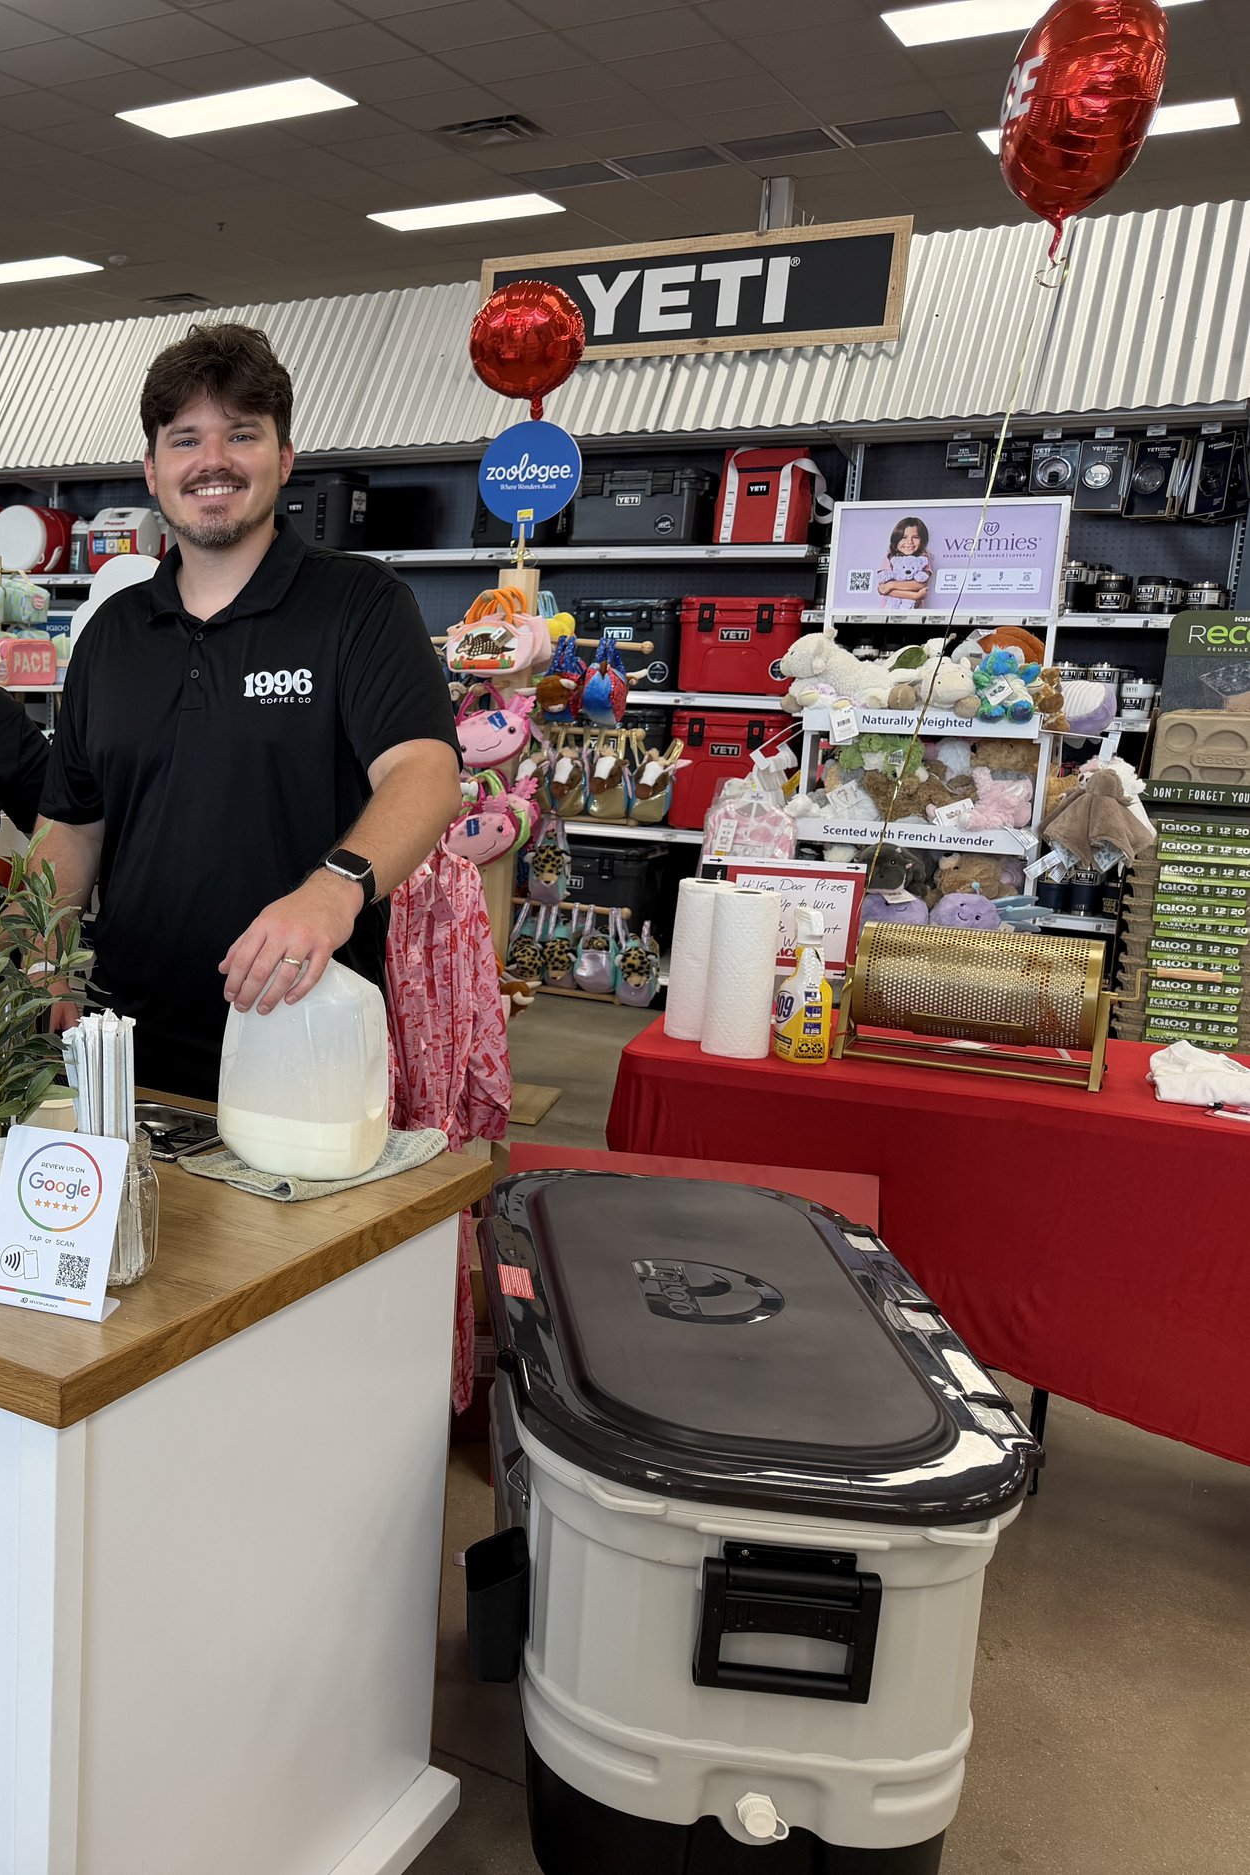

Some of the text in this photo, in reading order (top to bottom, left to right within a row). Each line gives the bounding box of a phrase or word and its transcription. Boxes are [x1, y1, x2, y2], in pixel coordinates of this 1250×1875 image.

[486, 452, 571, 483] zoologee
[618, 496, 638, 504] YETI
[945, 533, 1038, 551] warmies
[46, 624, 70, 632] IGLOO
[606, 629, 630, 639] YETI
[722, 630, 748, 639] YETI
[243, 668, 313, 698] 1996
[260, 696, 295, 705] COFFEE
[862, 715, 973, 729] Naturally Weighted
[712, 745, 738, 755] YETI
[1152, 787, 1184, 800] DON'T
[1188, 789, 1226, 802] FORGET
[822, 825, 994, 847] Scented with French Lavender
[1161, 823, 1250, 836] IGLOO 5 12 20
[1161, 842, 1202, 851] IGLOO
[1219, 846, 1232, 854] 12
[1235, 847, 1250, 855] 20
[1164, 865, 1205, 874] IGLOO
[1222, 868, 1235, 876] 12
[1238, 869, 1250, 877] 20
[779, 879, 848, 893] Door Prizes
[1158, 883, 1198, 892] IGLOO
[1215, 887, 1227, 895] 12
[1231, 888, 1246, 896] 20
[812, 900, 836, 910] Win
[1156, 903, 1245, 916] IGLOO 5 12 20
[1151, 940, 1239, 955] IGLOO 5 12 20
[1151, 980, 1192, 990] IGLOO
[1209, 985, 1221, 993] 12
[1225, 986, 1239, 994] 20
[1149, 997, 1189, 1008] IGLOO
[1207, 1003, 1219, 1011] 12
[1223, 1004, 1237, 1012] 20
[1150, 1017, 1238, 1034] IGLOO 5 12 20
[41, 1161, 65, 1171] REVIEW
[28, 1171, 91, 1200] Google
[29, 1234, 42, 1242] TAP
[55, 1239, 75, 1248] SCAN
